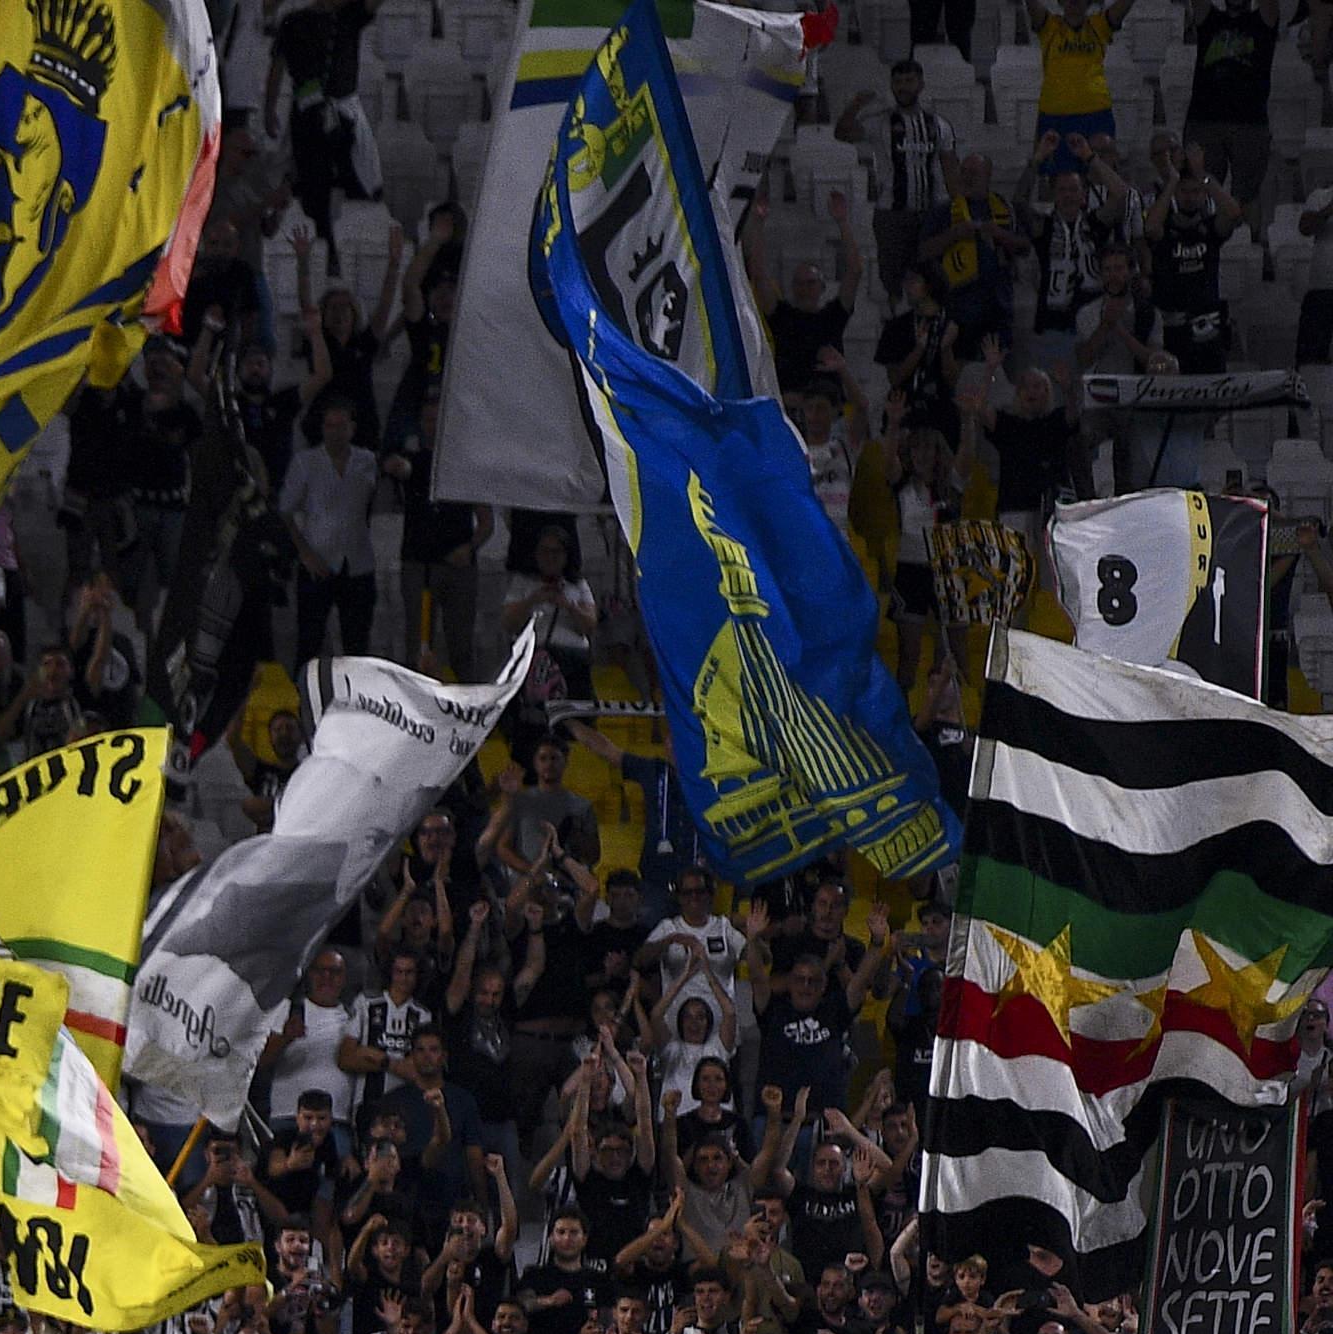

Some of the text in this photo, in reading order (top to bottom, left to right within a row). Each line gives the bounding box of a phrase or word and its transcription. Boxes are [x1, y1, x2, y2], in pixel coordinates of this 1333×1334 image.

[1096, 553, 1139, 626] 8
[1186, 1117, 1272, 1160] UNO
[1174, 1162, 1275, 1220] OTTO
[1164, 1227, 1277, 1286] NOVE
